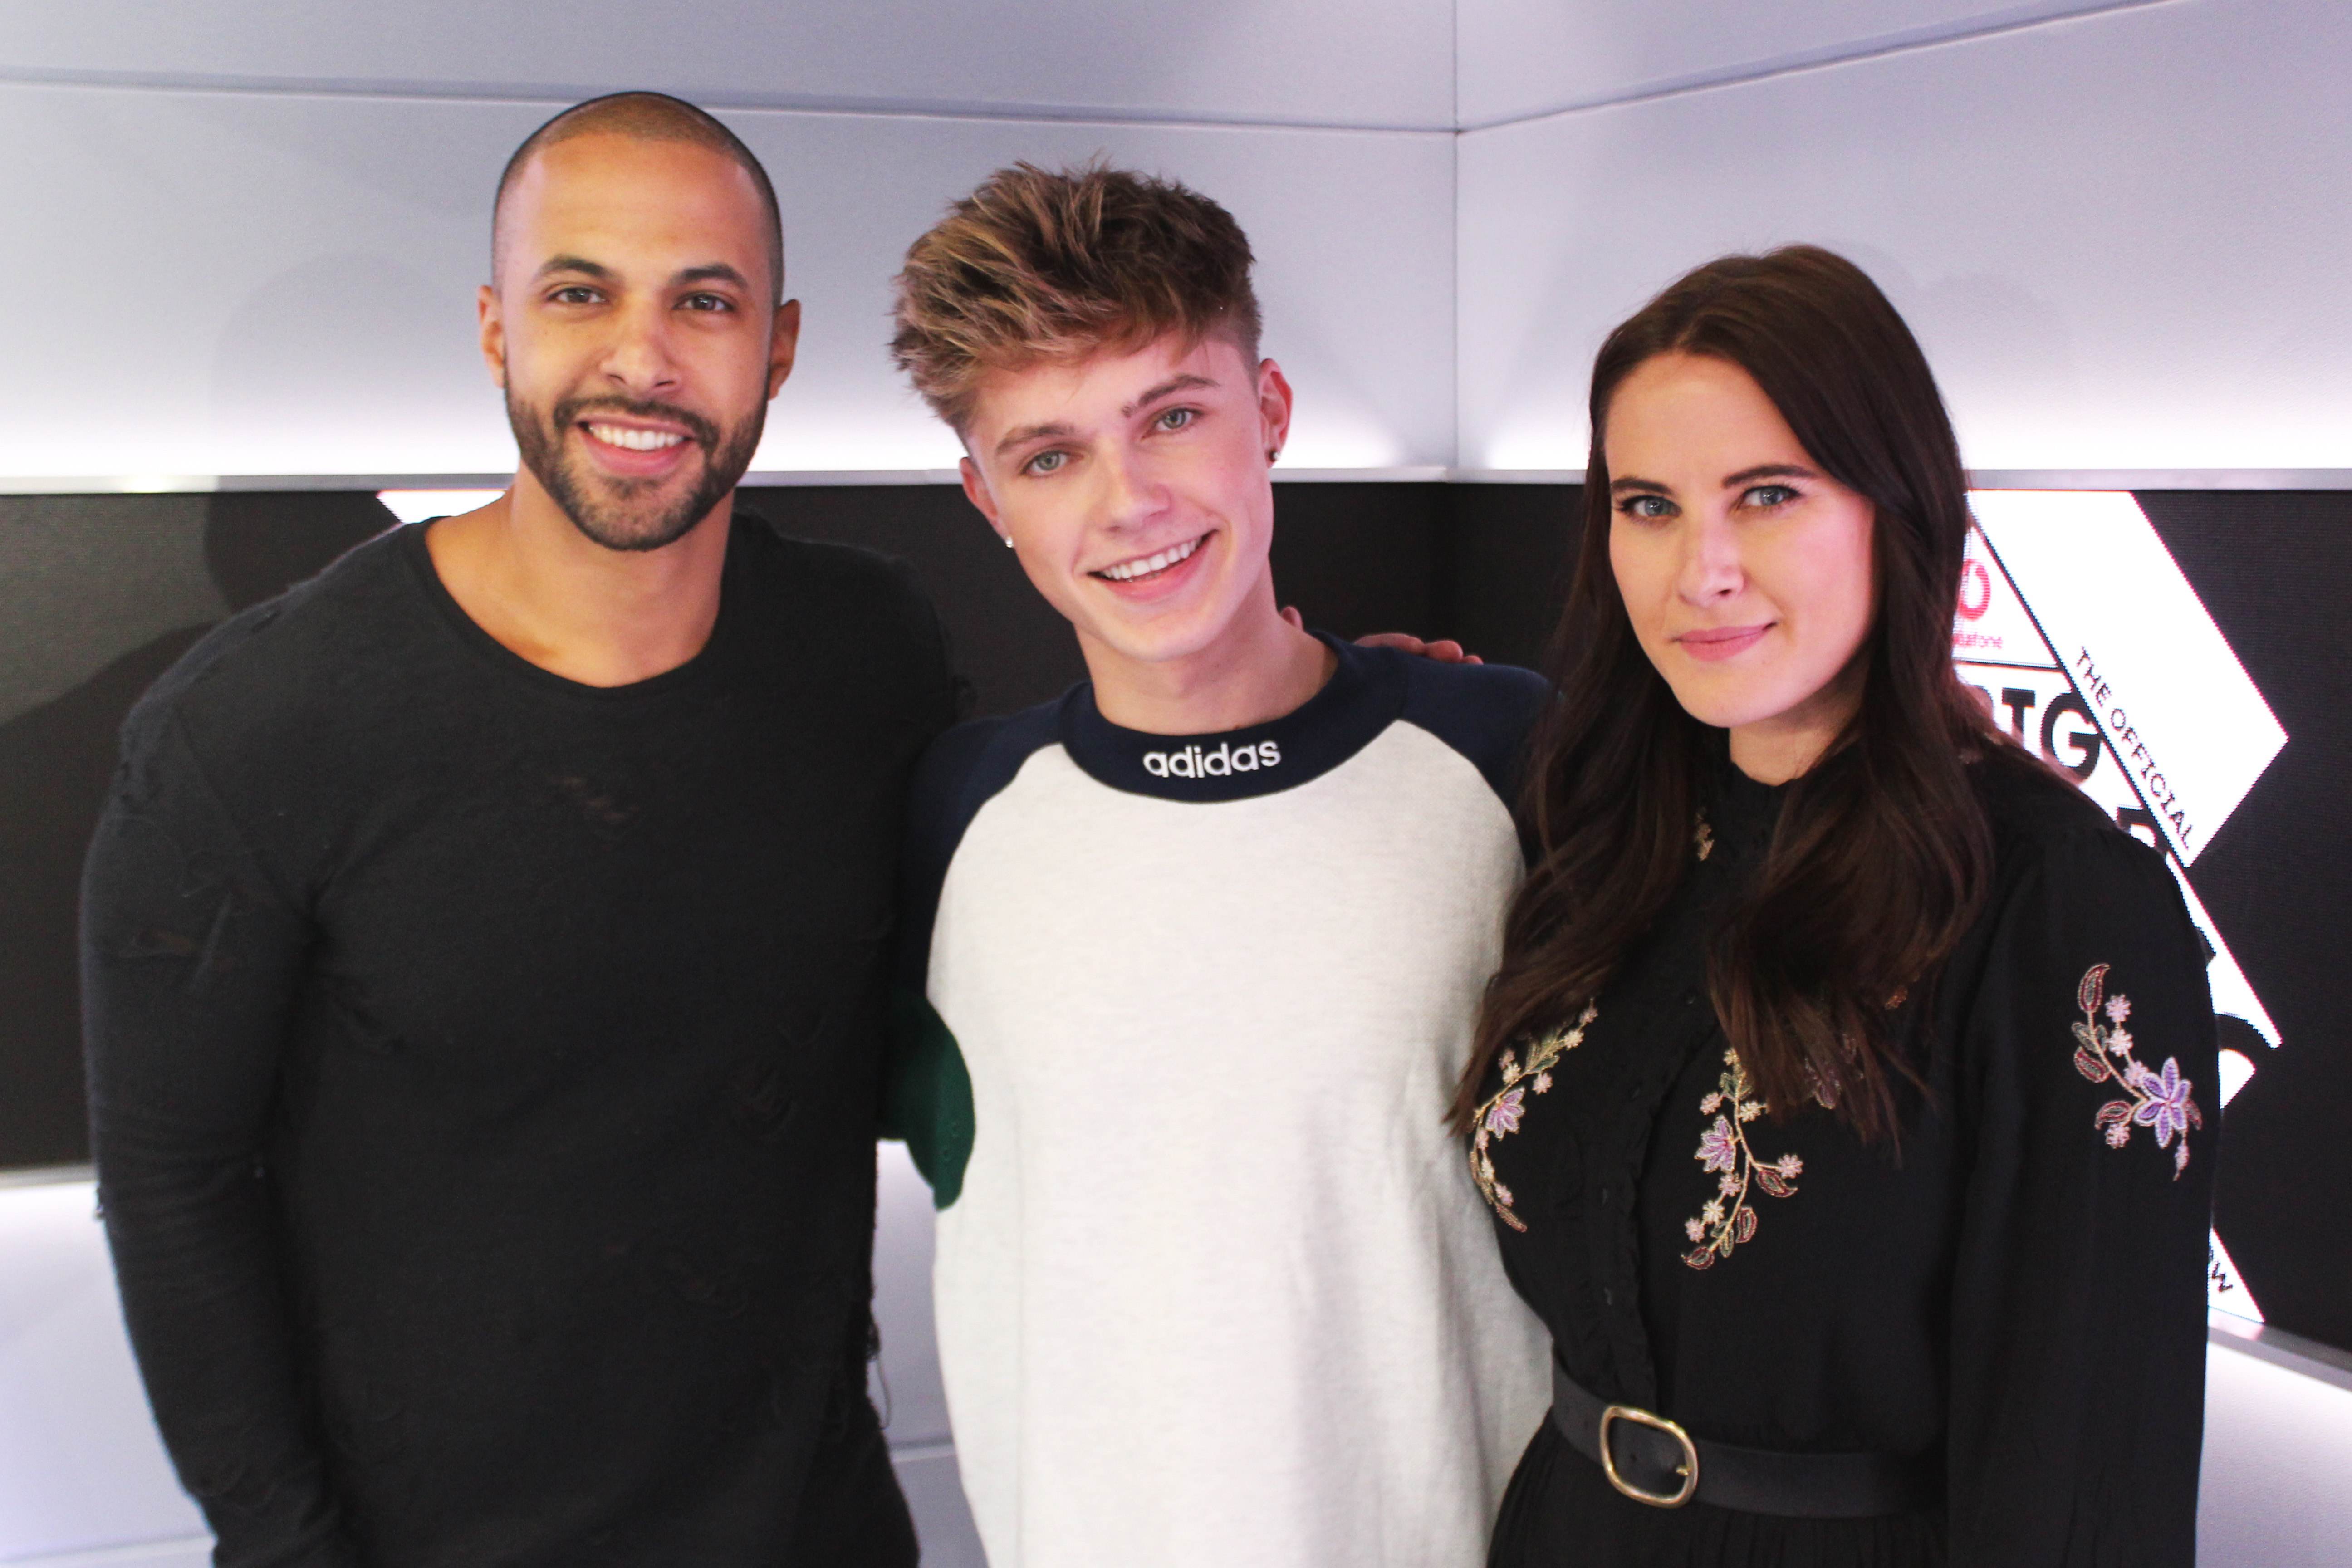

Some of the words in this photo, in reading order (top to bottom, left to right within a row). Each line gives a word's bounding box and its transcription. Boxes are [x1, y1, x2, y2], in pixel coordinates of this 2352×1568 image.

[1143, 740, 1282, 779] adidas
[2076, 646, 2112, 708] THE
[2110, 707, 2193, 851] OFFICIAL
